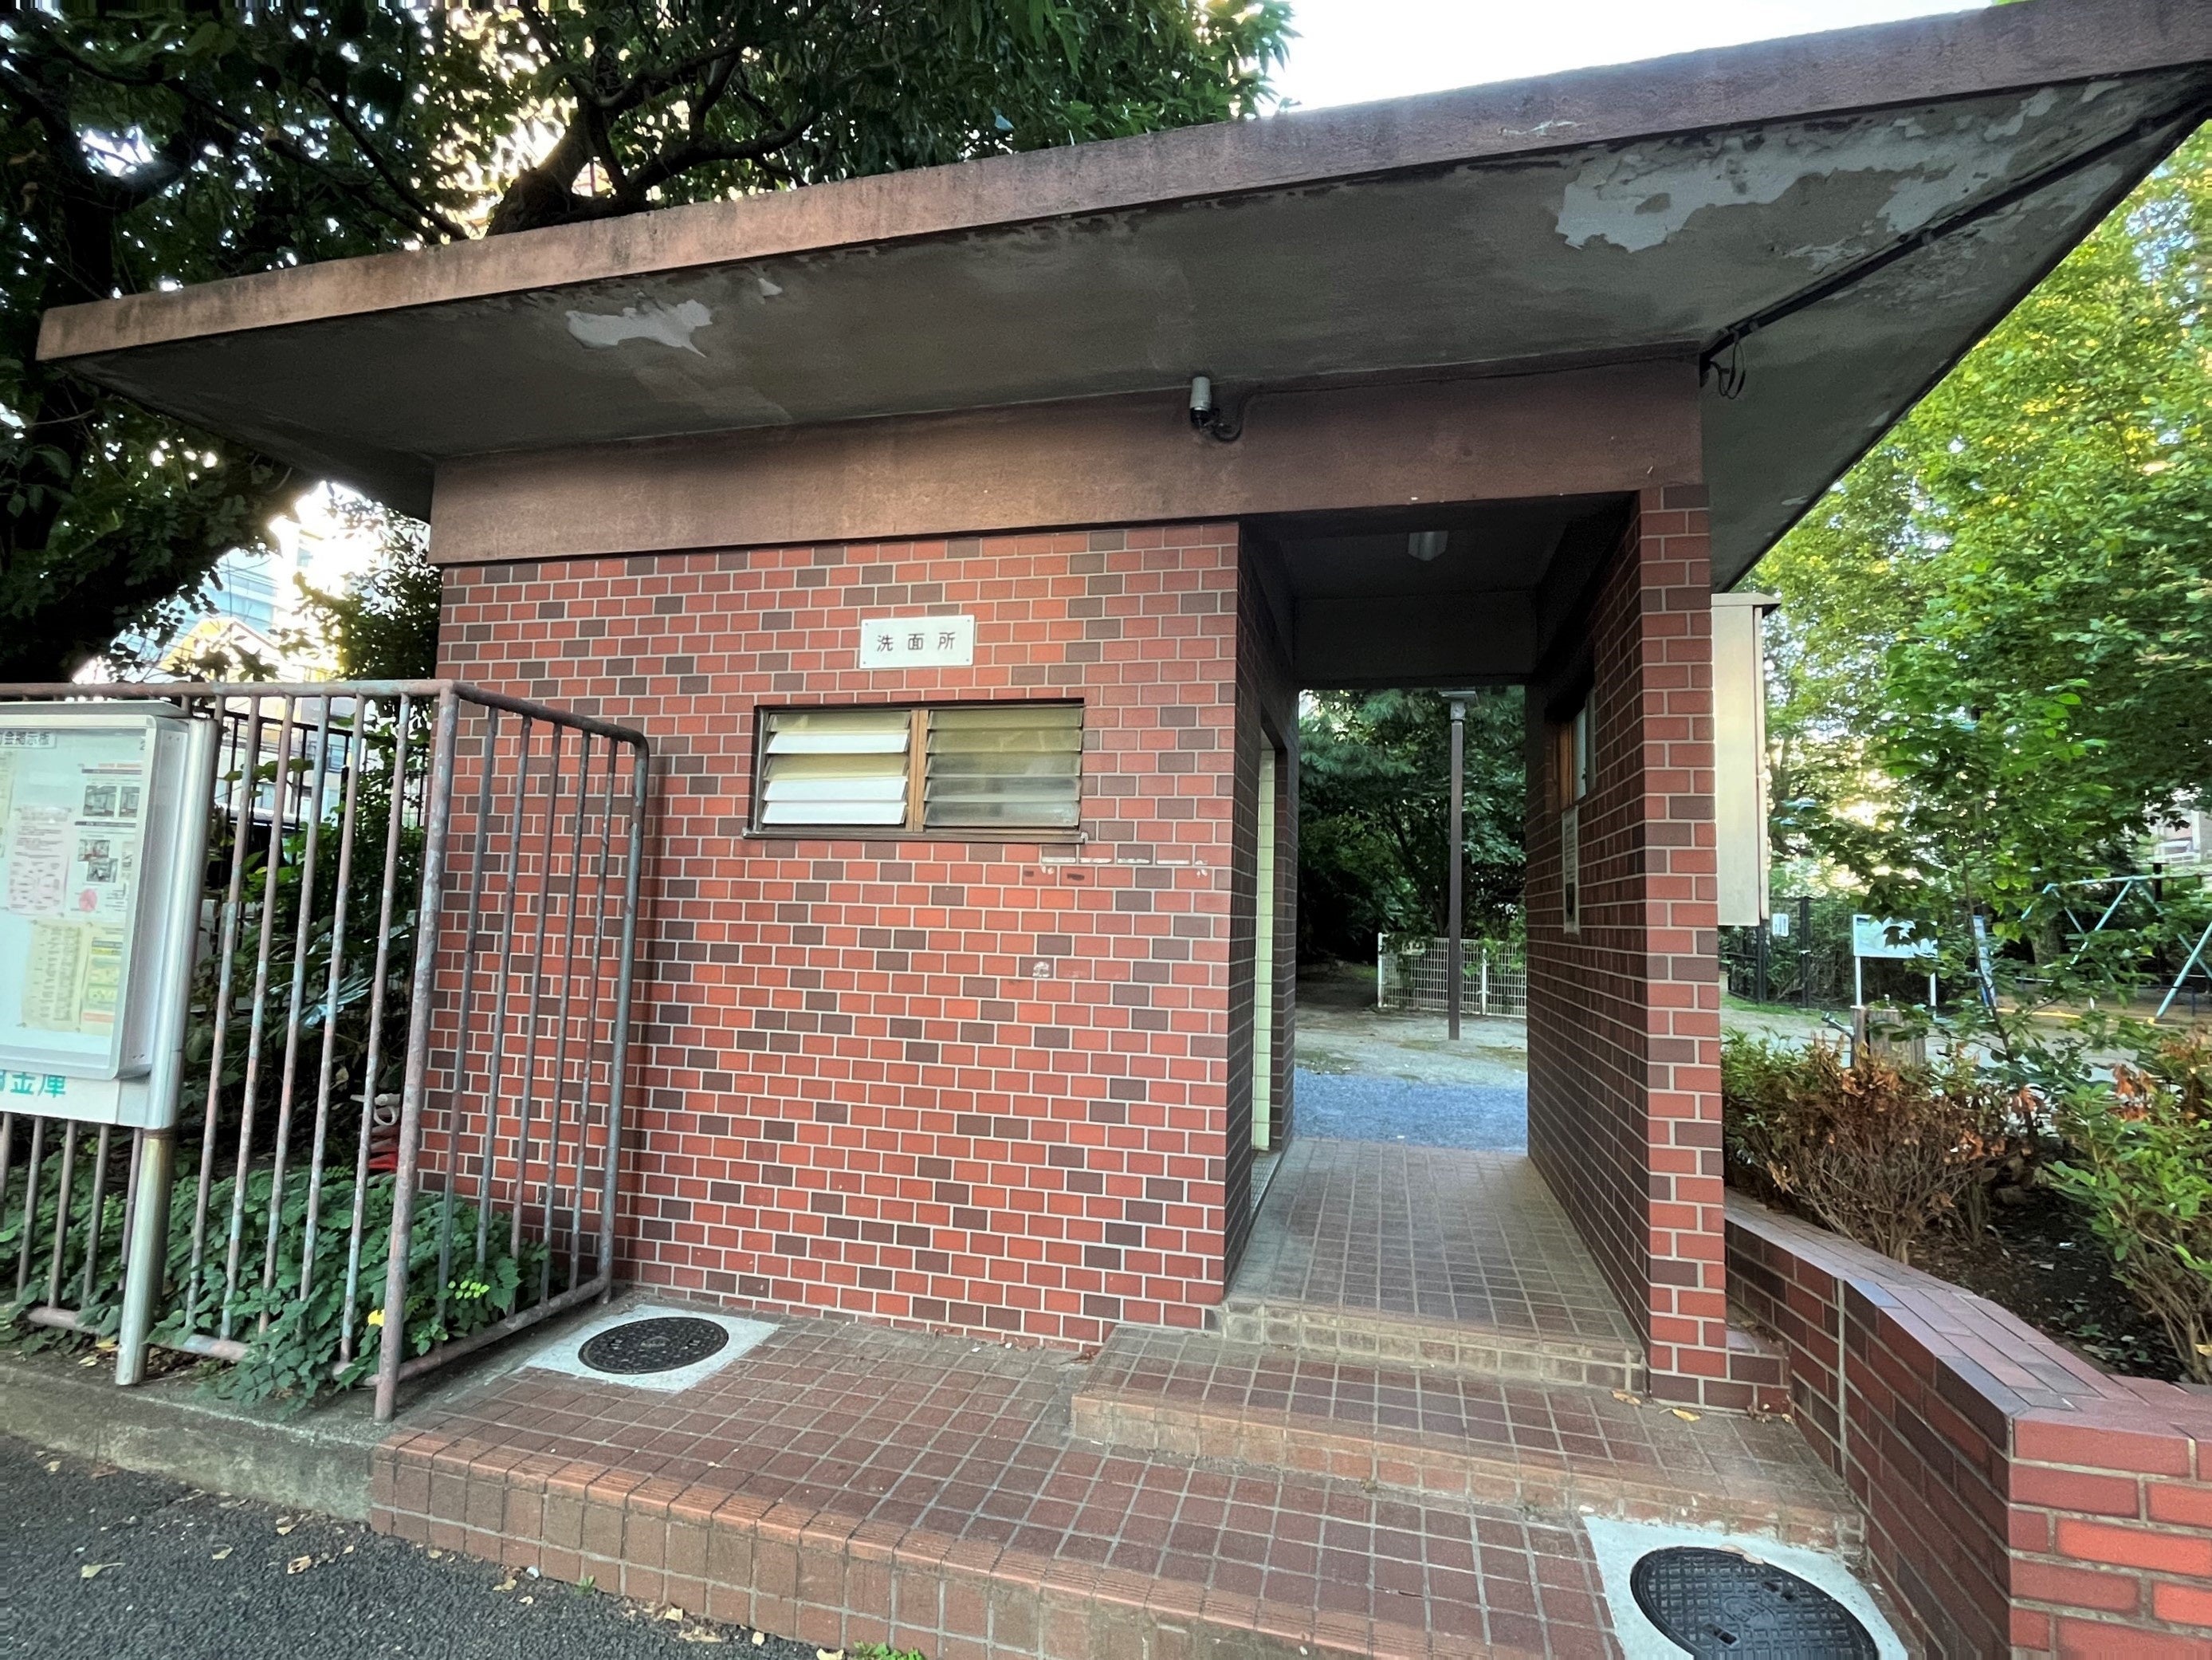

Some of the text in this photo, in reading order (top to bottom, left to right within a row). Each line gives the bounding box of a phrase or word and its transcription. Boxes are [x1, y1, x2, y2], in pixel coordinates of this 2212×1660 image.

[876, 631, 956, 652] 洗面所
[0, 730, 51, 745] 会掲示板
[0, 1071, 66, 1098] 金庫
